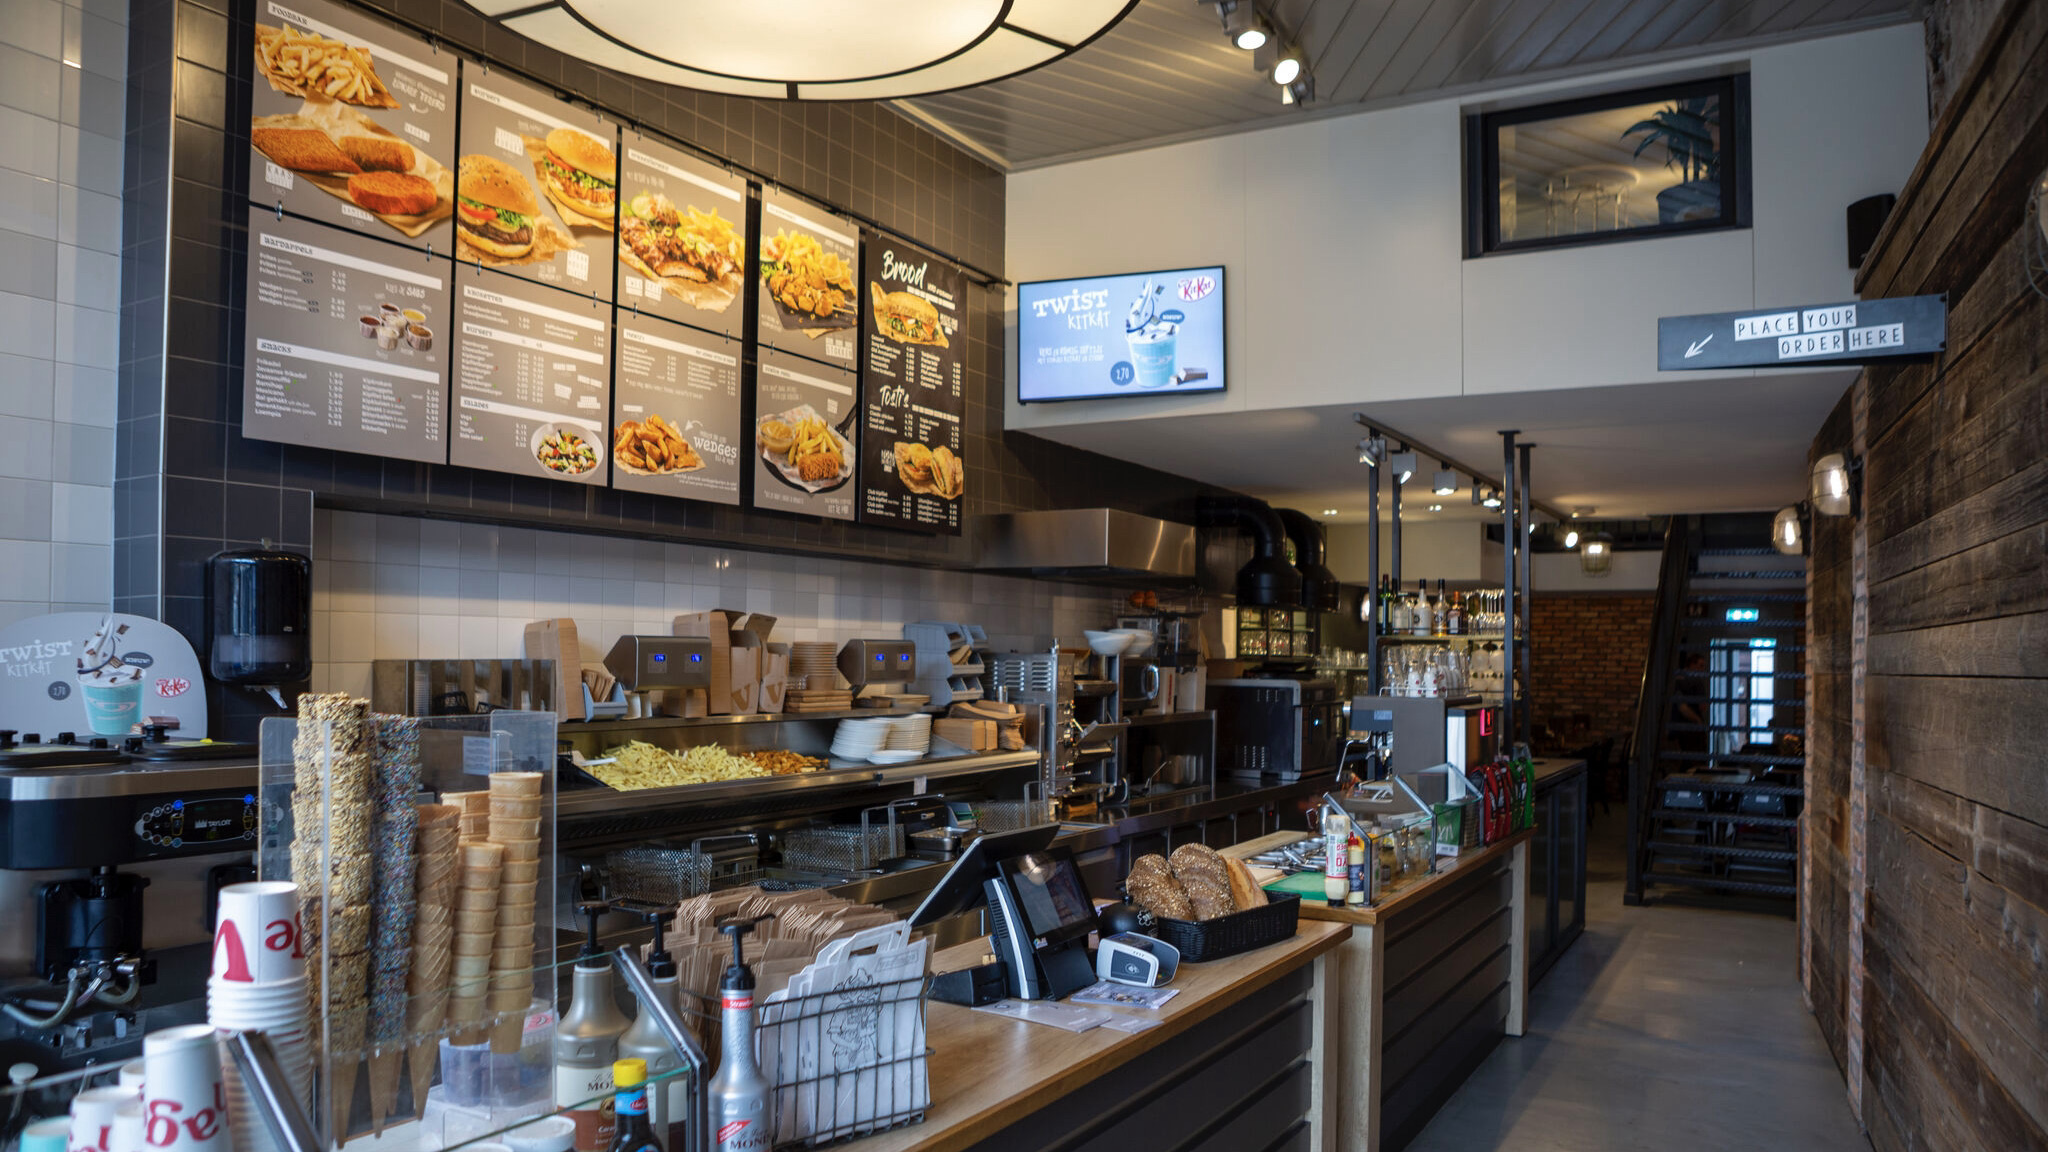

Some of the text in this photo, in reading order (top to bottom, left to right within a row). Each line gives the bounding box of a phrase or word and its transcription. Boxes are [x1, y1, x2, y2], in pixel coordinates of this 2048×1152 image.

[881, 249, 928, 290] Brood
[1184, 277, 1211, 300] KitKat
[1067, 310, 1111, 331] KITKAT
[1737, 308, 1854, 337] PLACE YOUR
[1781, 328, 1901, 355] ORDER HERE
[6, 660, 52, 677] KITKAT
